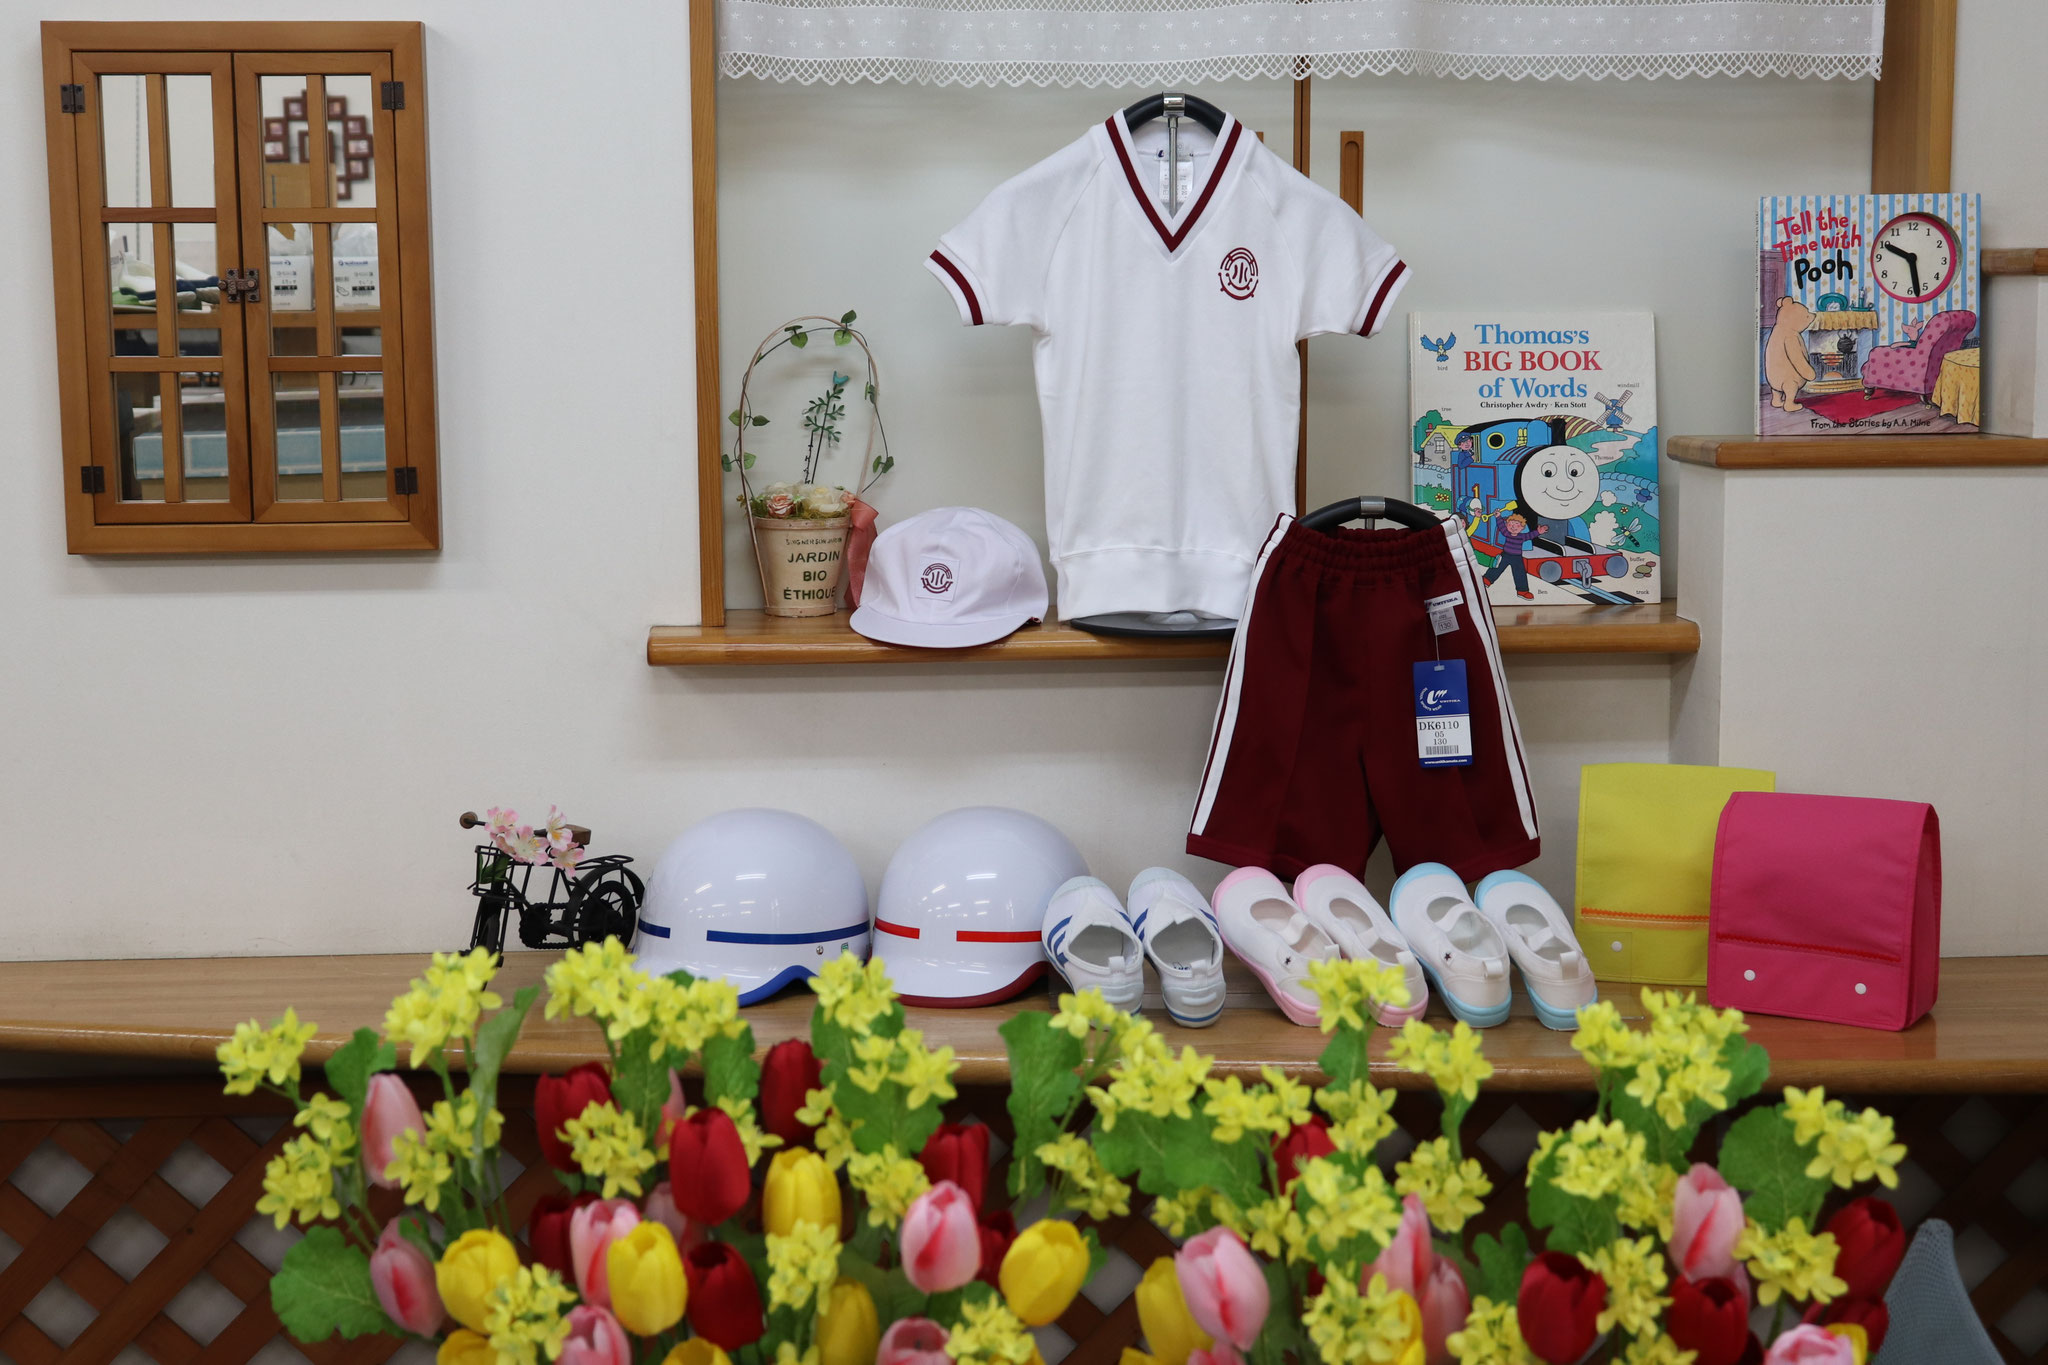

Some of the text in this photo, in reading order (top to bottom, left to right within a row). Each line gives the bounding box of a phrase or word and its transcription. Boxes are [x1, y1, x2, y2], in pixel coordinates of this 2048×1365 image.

[1774, 207, 1849, 239] Tell the
[1908, 222, 1919, 231] 12
[1890, 228, 1900, 237] 11
[1926, 228, 1931, 236] 1
[1772, 224, 1862, 263] Time with
[1936, 240, 1943, 249] 2
[1876, 254, 1882, 262] 9
[1941, 257, 1947, 265] 3
[1794, 248, 1853, 289] Pooh
[1881, 270, 1888, 278] 8
[1933, 272, 1940, 281] 4
[1892, 281, 1898, 290] 7
[1922, 283, 1928, 291] 5
[1907, 287, 1913, 295] 6
[1474, 324, 1590, 344] Thomas's
[1463, 350, 1603, 371] BIG BOOK
[1478, 377, 1587, 398] of Words
[1480, 401, 1523, 410] Christopher
[1524, 401, 1548, 410] Awdry
[1810, 418, 1830, 429] From
[1833, 418, 1847, 428] the
[1848, 417, 1880, 428] Stories
[1881, 418, 1892, 428] by
[1910, 418, 1931, 427] Milne
[1471, 484, 1480, 500] 1
[787, 551, 840, 563] JARDIN
[803, 570, 827, 582] BIO
[783, 586, 836, 600] ÉTHIQUE
[1419, 721, 1460, 731] DK6110
[1434, 730, 1445, 738] 05
[1433, 738, 1447, 746] 130
